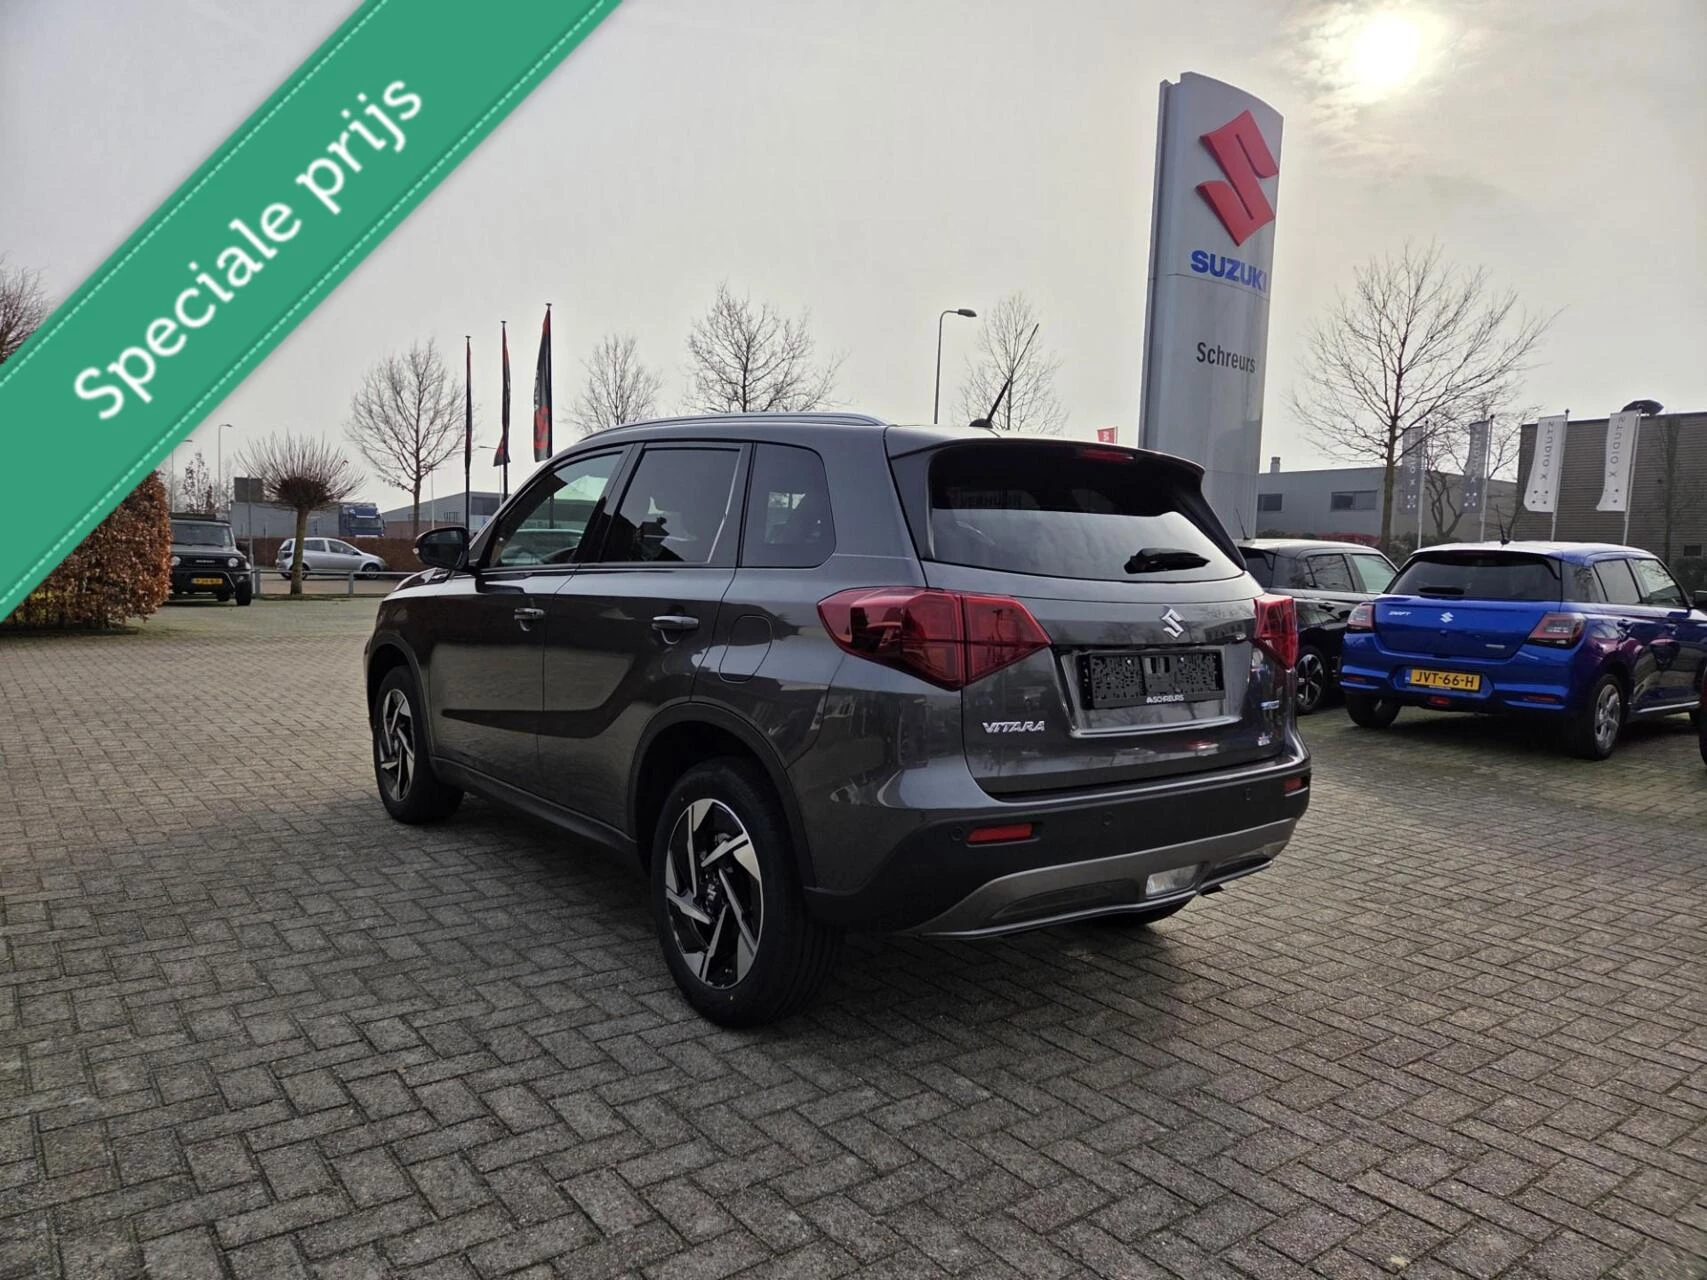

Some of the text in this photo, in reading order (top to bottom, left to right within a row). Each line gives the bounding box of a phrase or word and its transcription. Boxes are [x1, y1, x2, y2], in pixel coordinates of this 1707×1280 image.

[1191, 249, 1267, 293] SUZUKI
[1196, 341, 1256, 374] Schreurs
[1415, 671, 1474, 688] JVT-66-H
[982, 720, 1045, 733] VITARA
